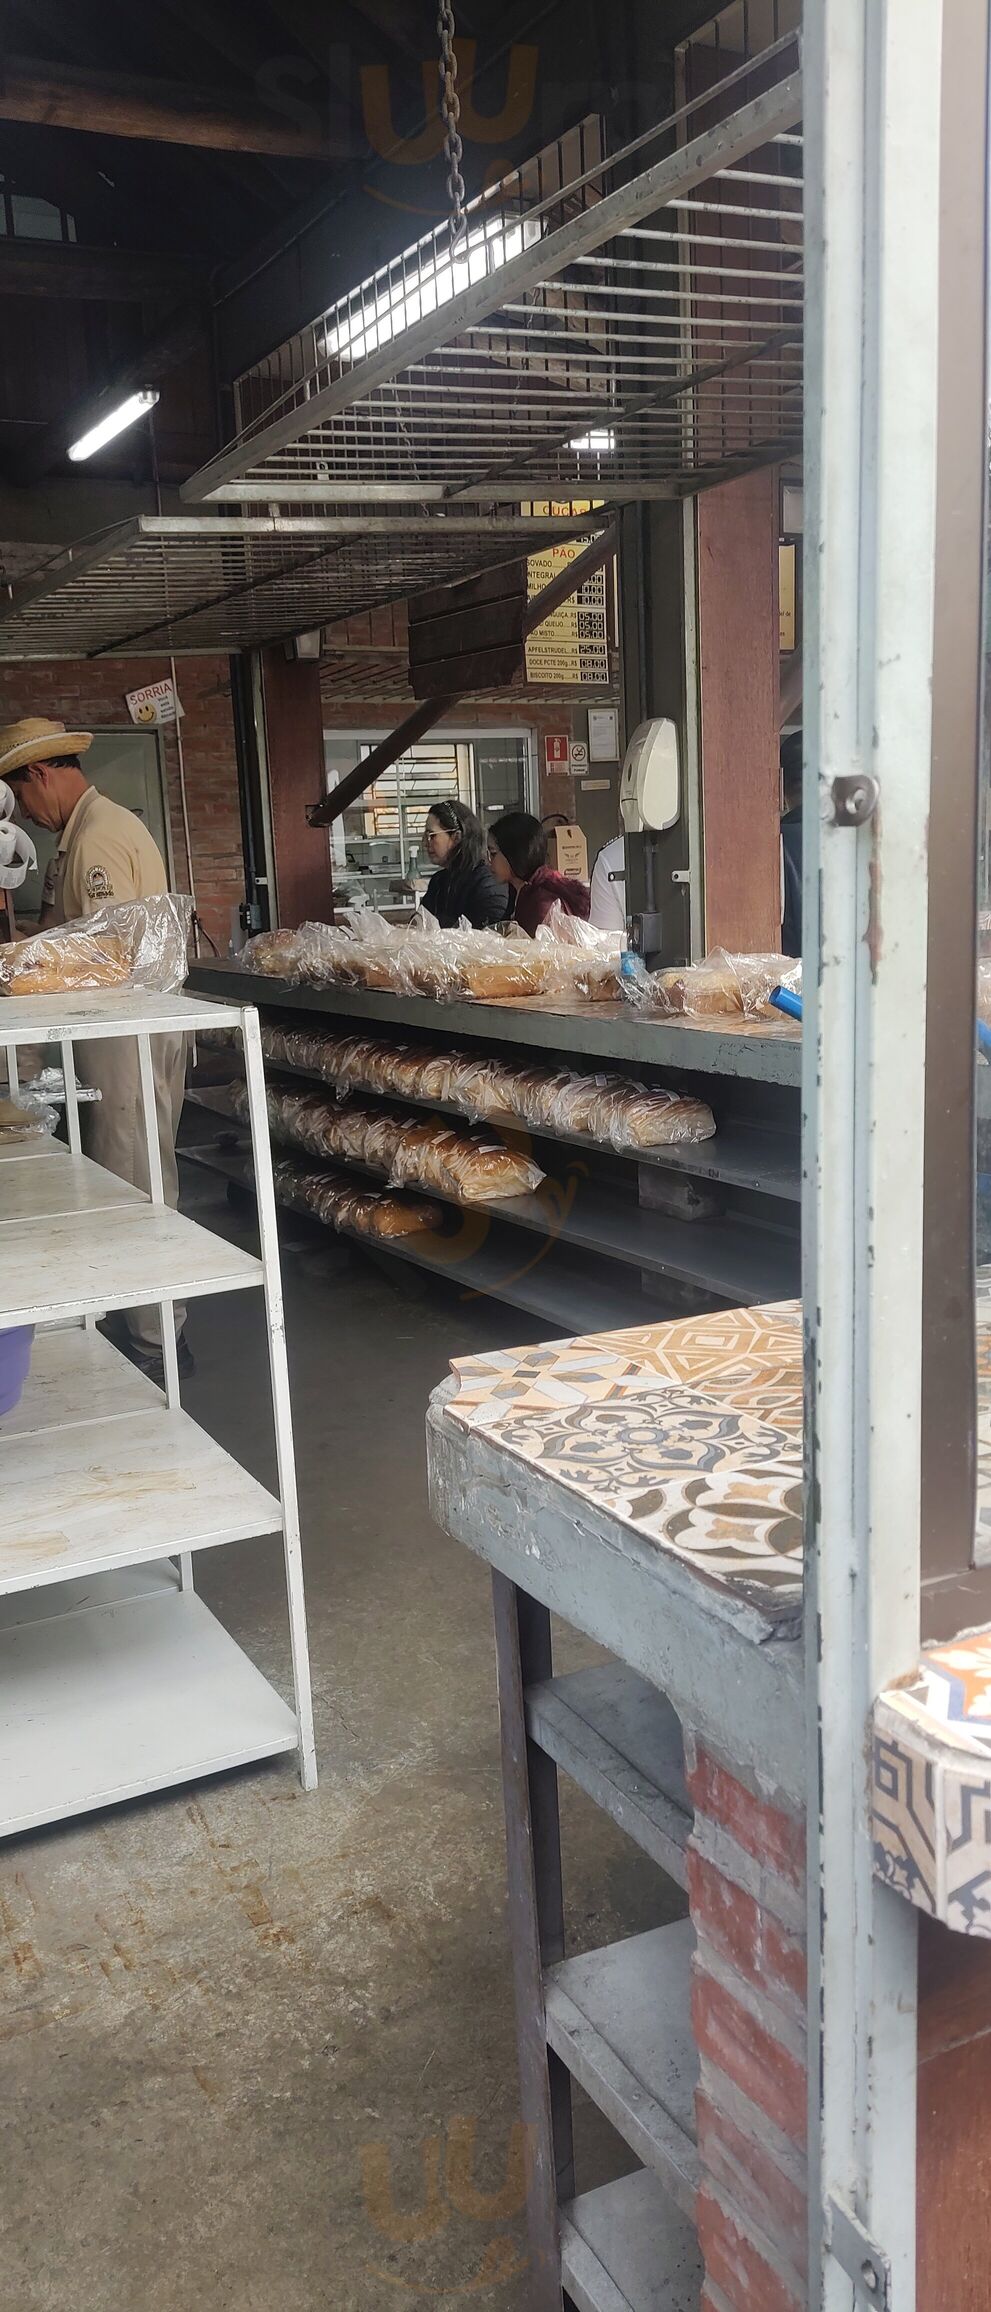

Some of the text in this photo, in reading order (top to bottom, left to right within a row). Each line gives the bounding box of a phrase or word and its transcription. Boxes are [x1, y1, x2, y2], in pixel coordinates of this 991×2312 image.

[552, 546, 576, 558] PÃO
[527, 571, 556, 579] NTEGRAL
[130, 683, 172, 705] SORRIA
